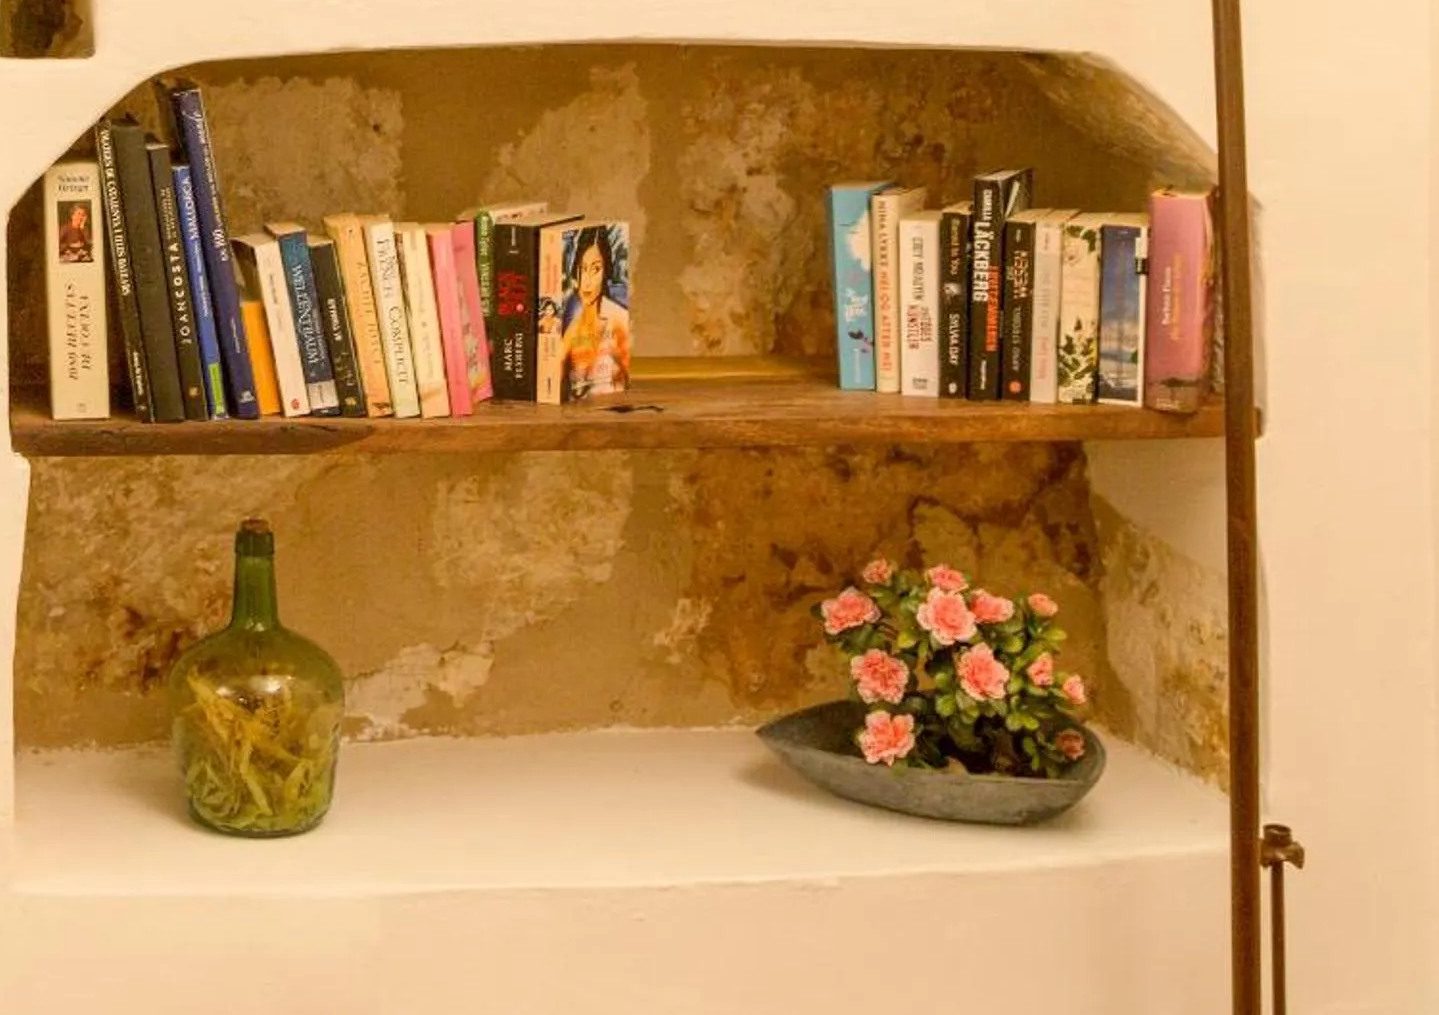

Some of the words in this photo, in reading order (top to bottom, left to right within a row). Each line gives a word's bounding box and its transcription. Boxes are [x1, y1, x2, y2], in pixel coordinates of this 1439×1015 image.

[184, 176, 200, 239] MALLORCA
[972, 221, 994, 301] LÄCKBERG
[948, 313, 960, 345] SYLVIA
[504, 338, 512, 370] MARC
[948, 346, 958, 365] DAY
